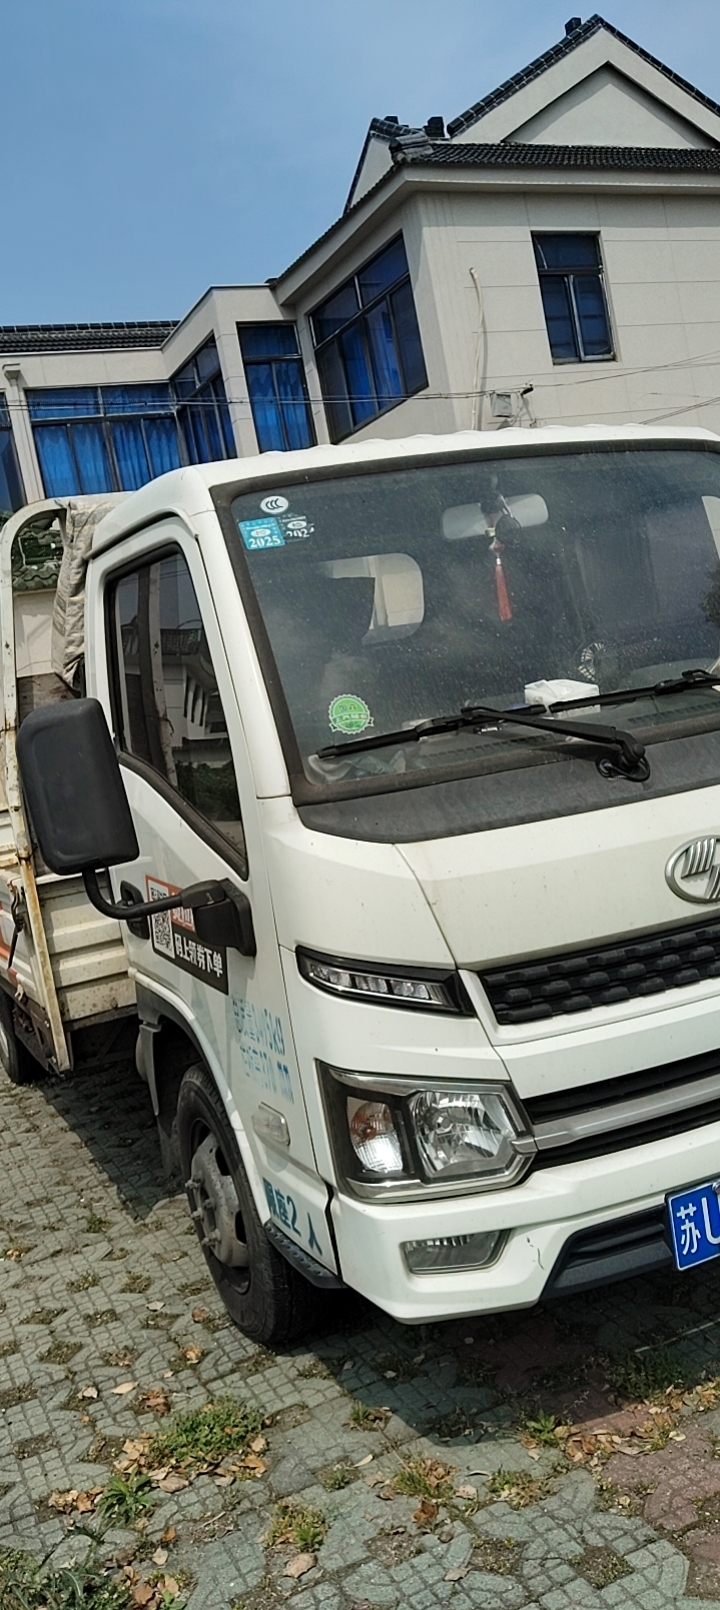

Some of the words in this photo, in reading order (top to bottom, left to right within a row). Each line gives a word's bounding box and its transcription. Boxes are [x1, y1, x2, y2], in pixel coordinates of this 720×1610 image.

[248, 535, 281, 548] 2025
[174, 933, 223, 978] 码上领券下单
